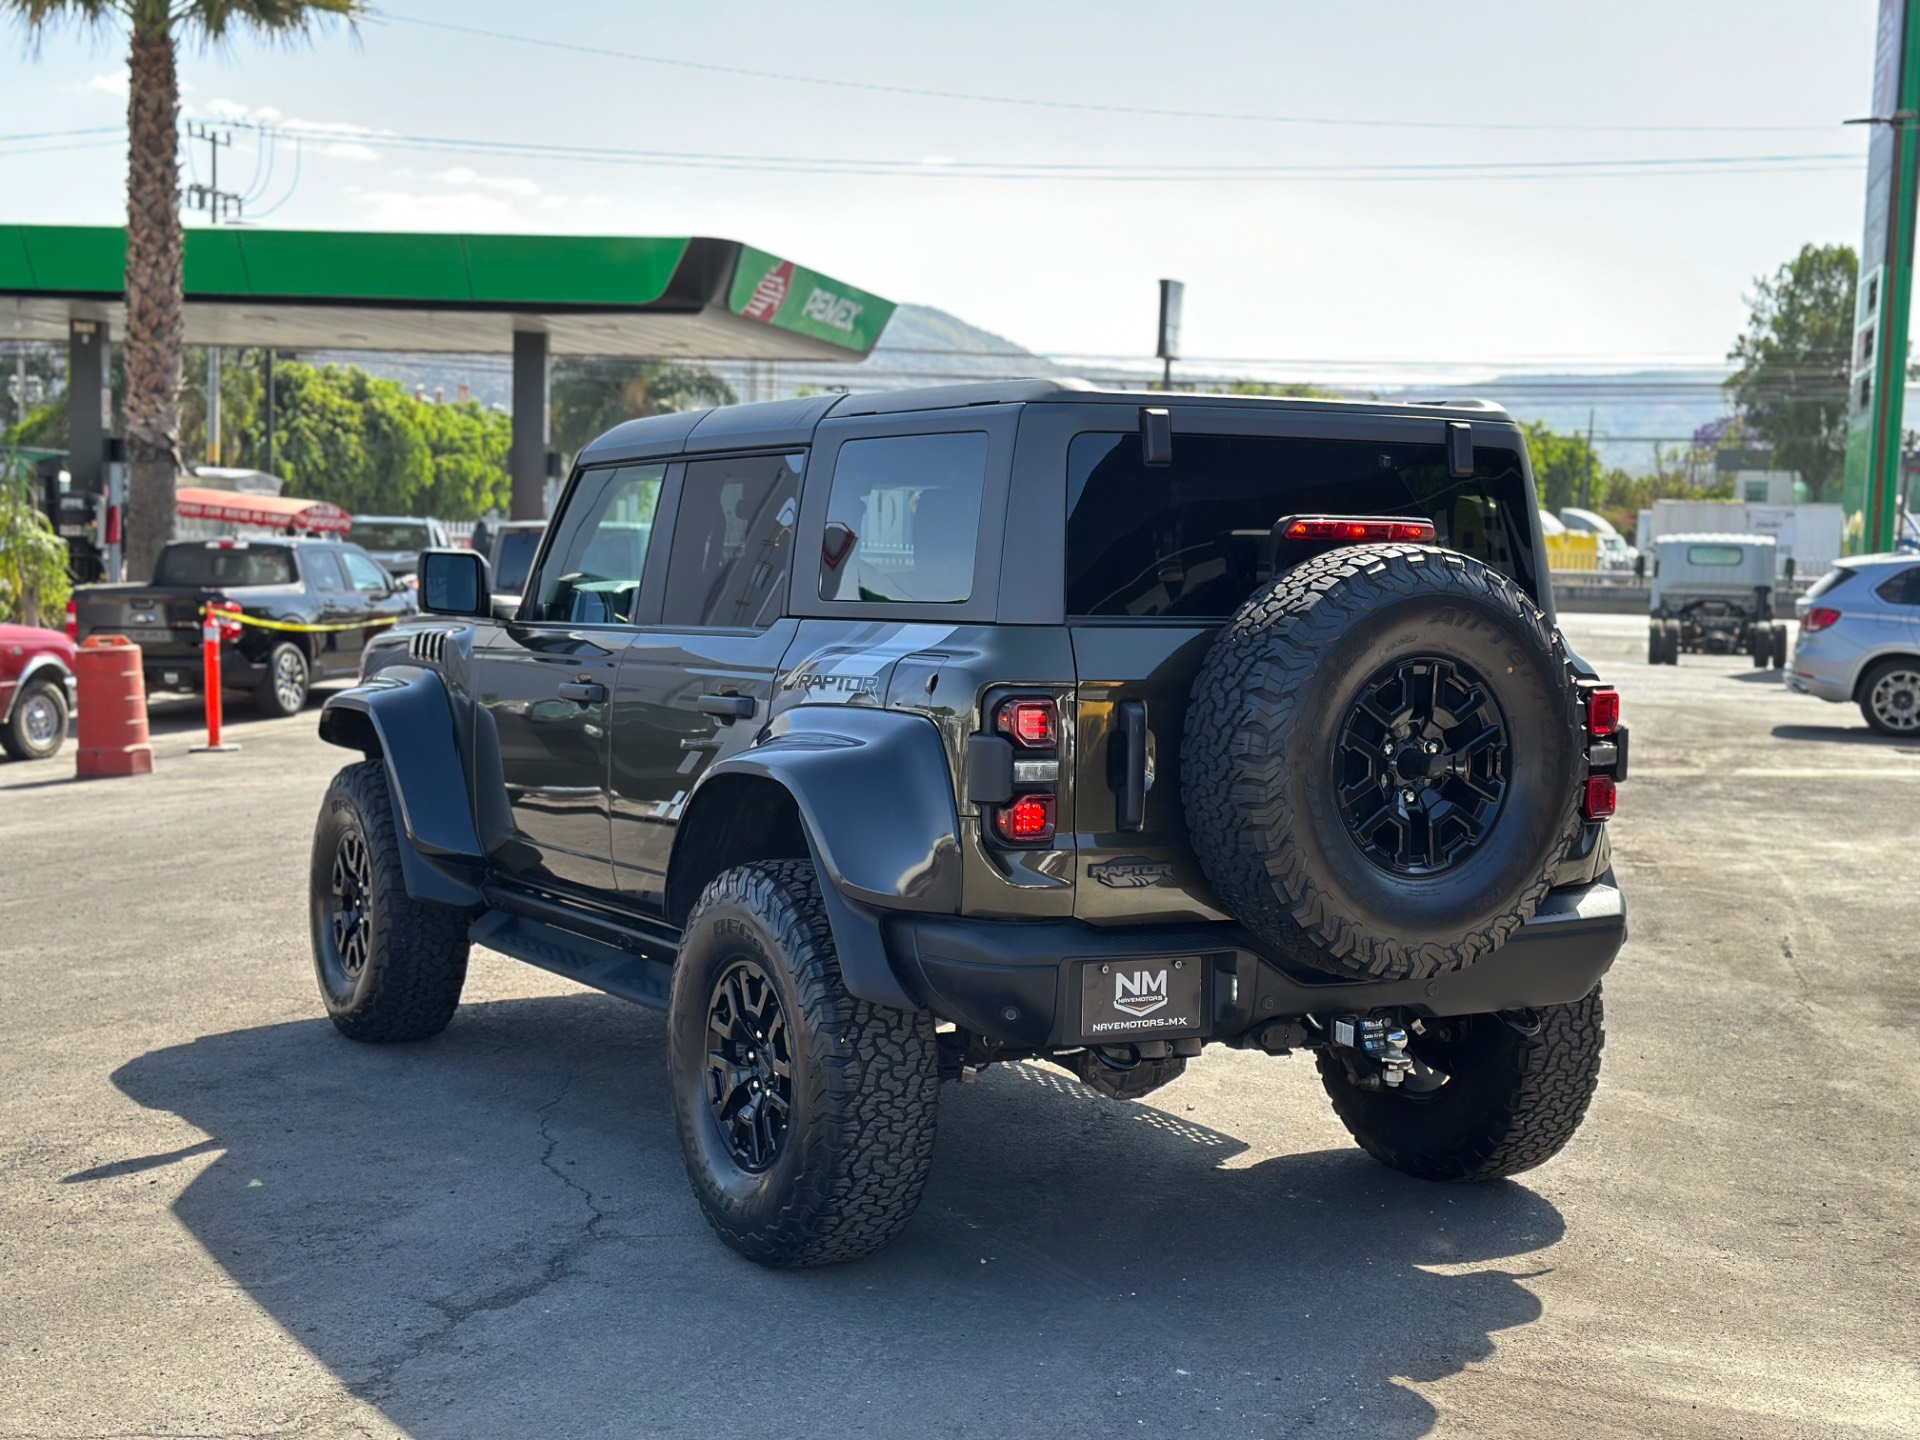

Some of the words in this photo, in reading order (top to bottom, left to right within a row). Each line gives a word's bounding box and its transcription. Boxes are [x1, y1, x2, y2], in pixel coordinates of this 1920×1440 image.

[801, 287, 864, 333] PEMEX
[797, 673, 880, 703] RAPTOR
[1091, 863, 1177, 884] RAPTOR
[1115, 969, 1167, 1000] NM
[1117, 995, 1162, 1004] NAVEMOTORS
